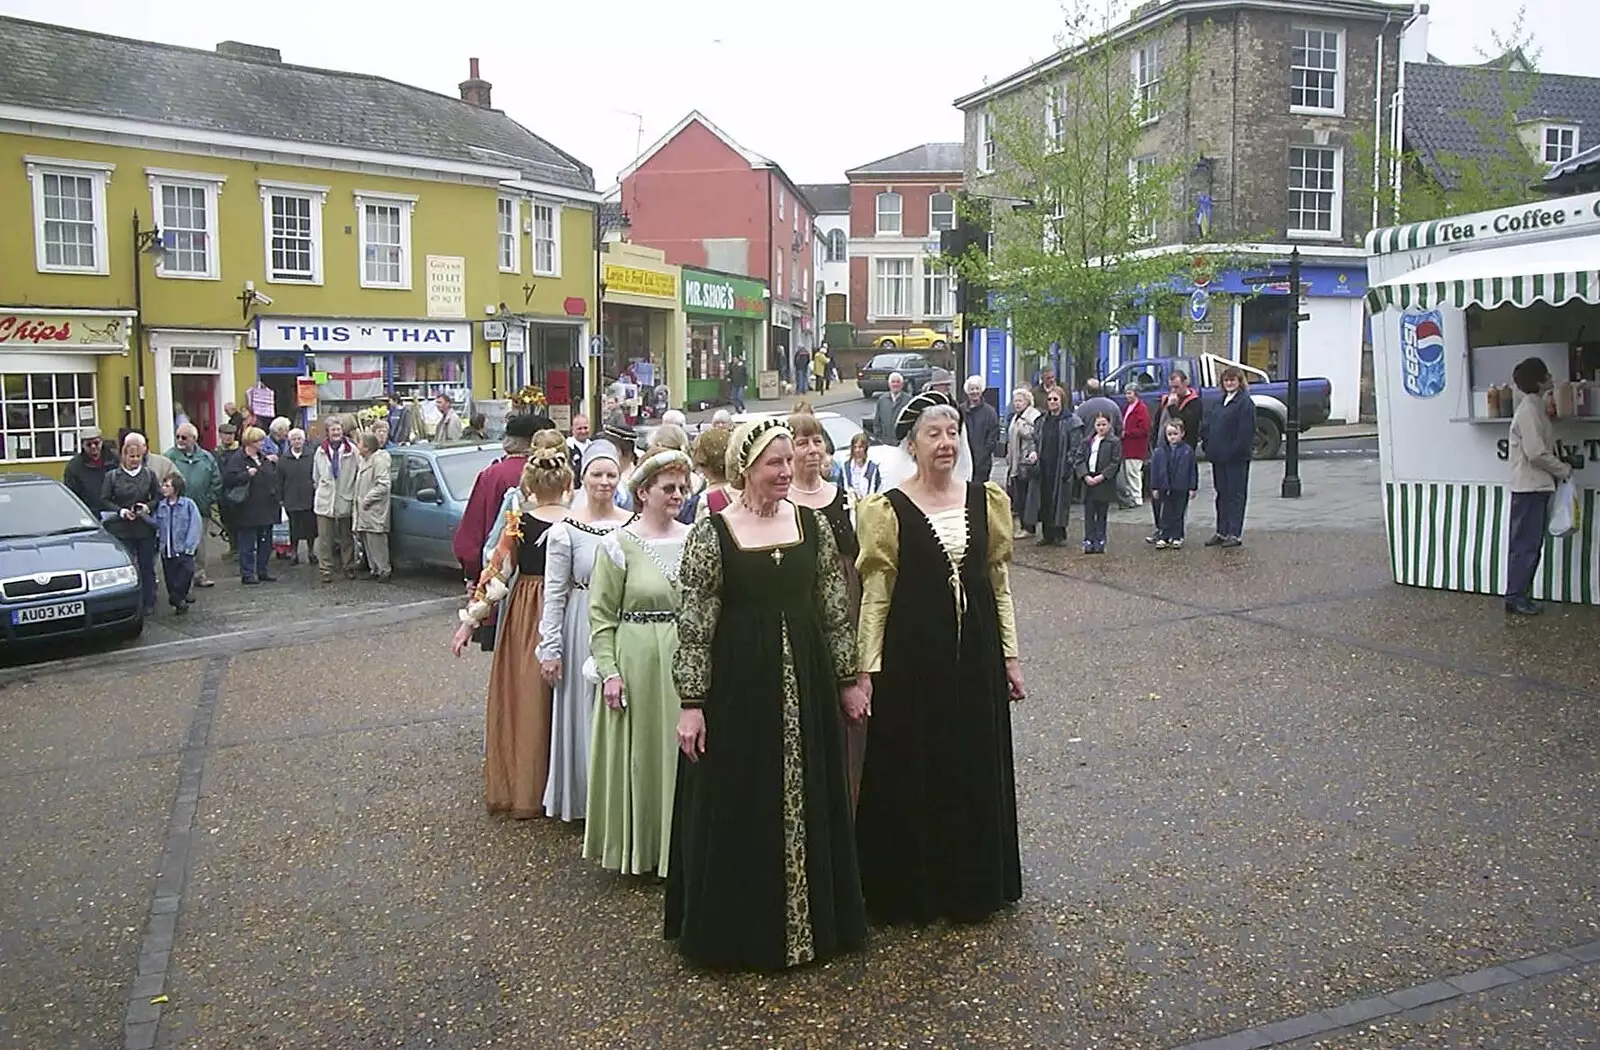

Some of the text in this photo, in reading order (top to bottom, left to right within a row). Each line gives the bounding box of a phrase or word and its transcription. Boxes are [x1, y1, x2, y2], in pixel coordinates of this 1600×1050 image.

[1439, 223, 1475, 242] Tea
[1493, 208, 1566, 234] Coffee
[432, 273, 460, 283] TO LET
[0, 316, 72, 344] Chips
[277, 326, 350, 342] THIS
[382, 328, 456, 343] THAT
[1404, 322, 1420, 394] PEPSI
[22, 603, 82, 622] AU03 KXP
